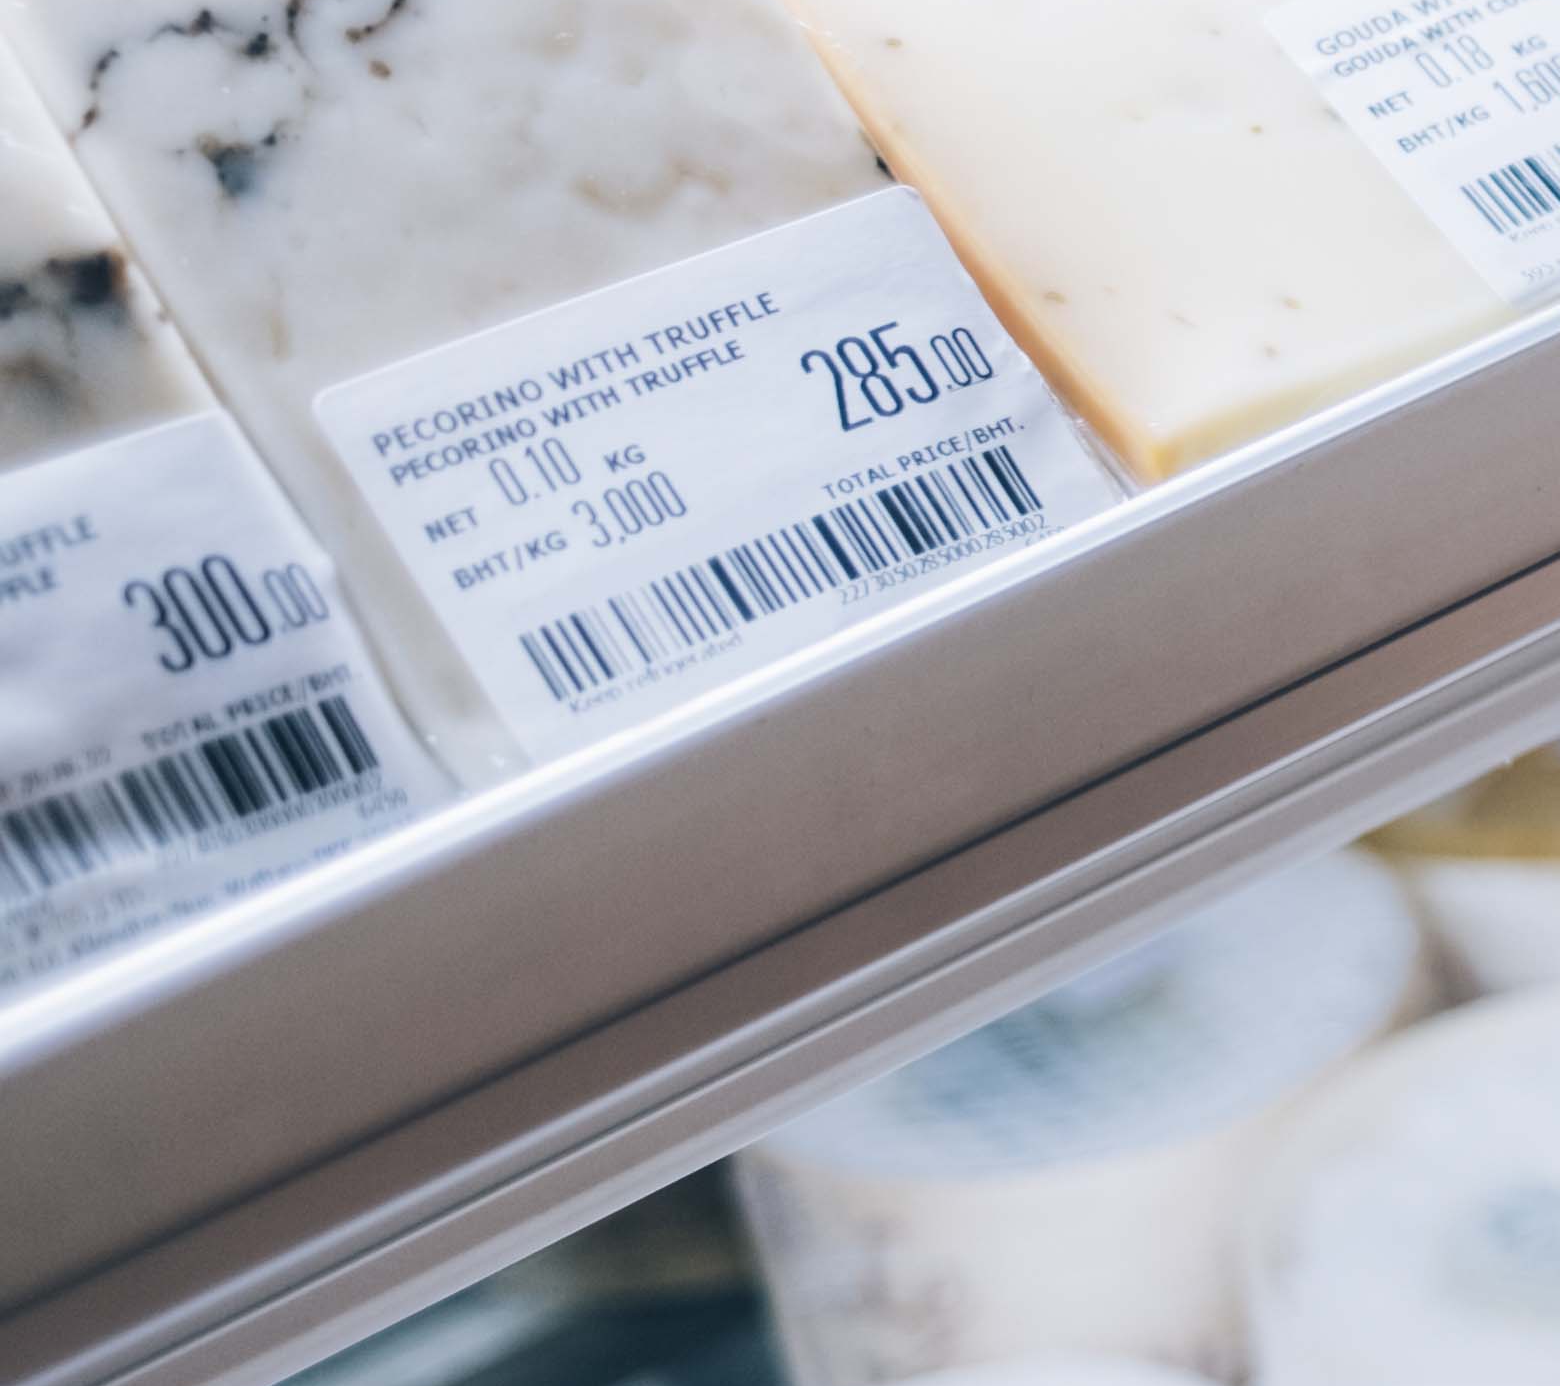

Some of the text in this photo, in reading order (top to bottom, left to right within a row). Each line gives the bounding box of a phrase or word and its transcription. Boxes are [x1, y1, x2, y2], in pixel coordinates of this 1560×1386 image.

[1314, 2, 1408, 57] GOUDA
[1333, 31, 1419, 79] GOUDA
[1415, 3, 1485, 46] WITH
[1367, 33, 1548, 122] NET 0.18 KG
[1396, 104, 1491, 156] BHT/KG
[371, 291, 780, 456] PECORINO WITH TRUFFLE
[389, 338, 746, 487] PECORINO WITH TRUFFLE
[799, 321, 997, 433] 285.00
[423, 437, 647, 544] NET 0.10 KG
[821, 417, 1027, 502] TOTAL PRICE/BHT.
[452, 470, 689, 591] BHT/KG 3,000
[122, 553, 330, 674] 300.00
[139, 710, 218, 753] TOTAL
